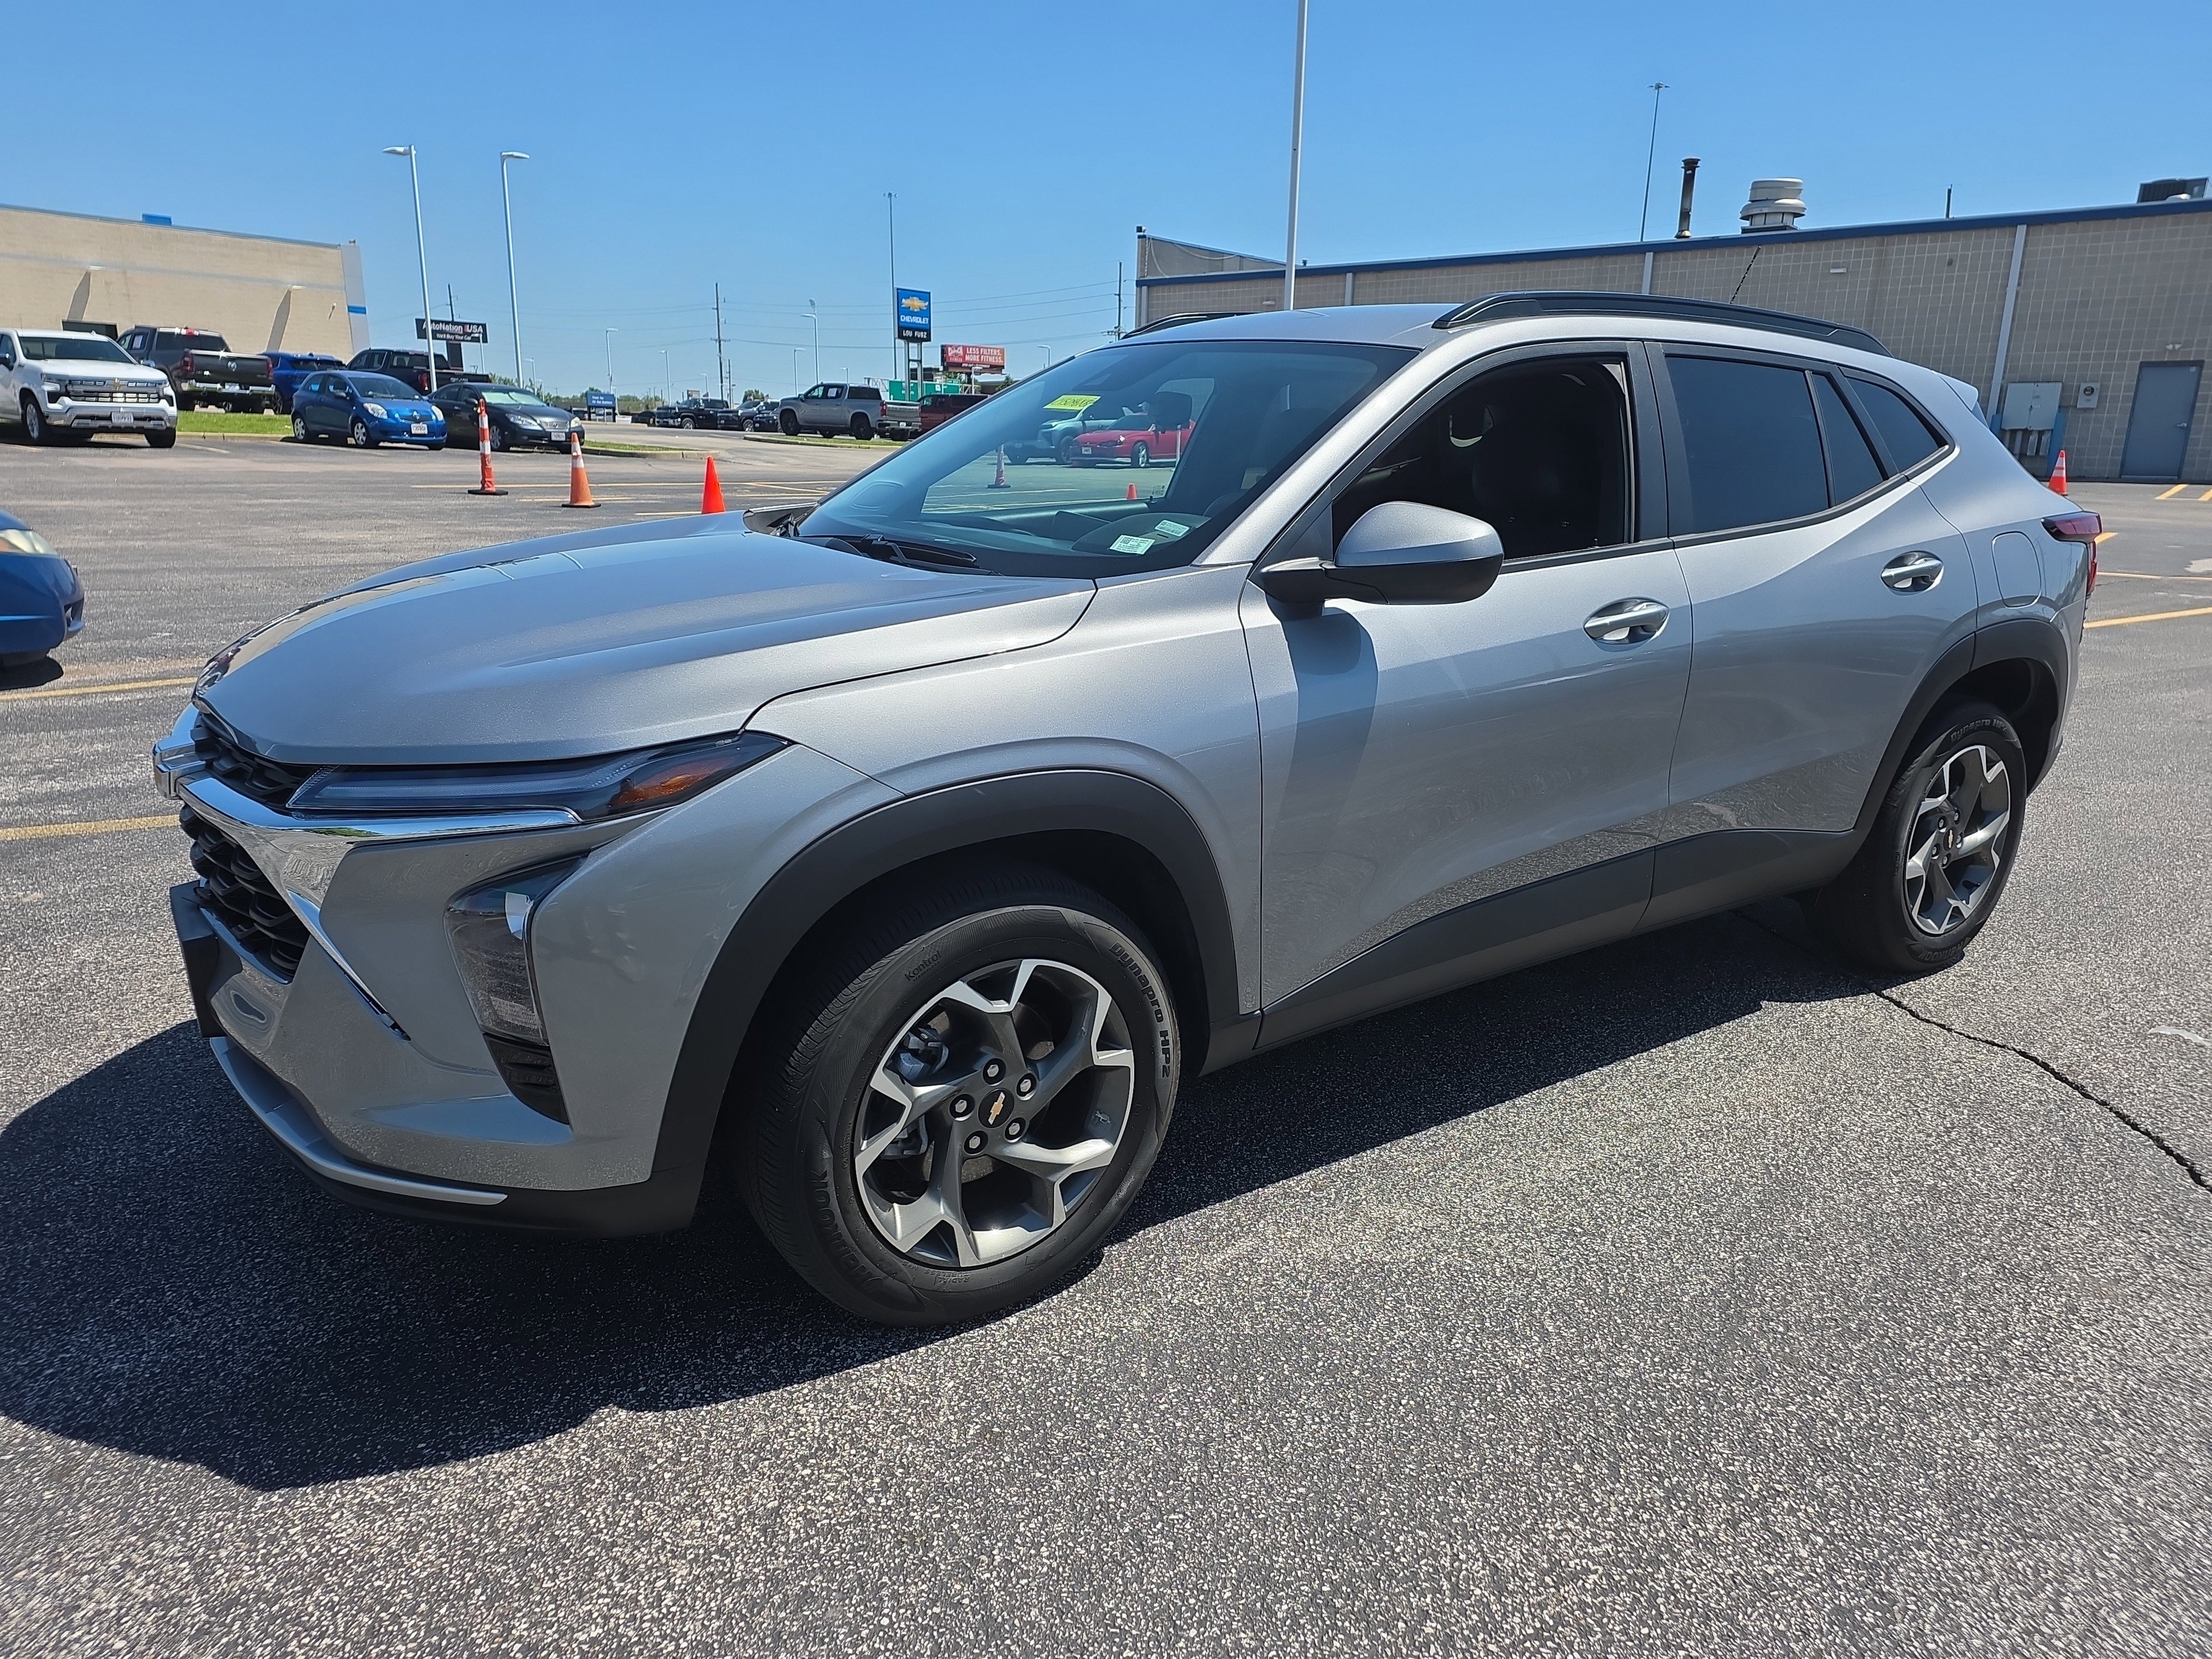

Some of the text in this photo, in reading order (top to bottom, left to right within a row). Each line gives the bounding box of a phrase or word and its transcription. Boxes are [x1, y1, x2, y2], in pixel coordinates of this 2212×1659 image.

[900, 315, 929, 324] CHEVROLET
[467, 324, 483, 333] USA
[981, 355, 1004, 363] FITNESS.
[904, 950, 941, 981] Kontrol
[1109, 941, 1171, 1078] Dynapro HP2
